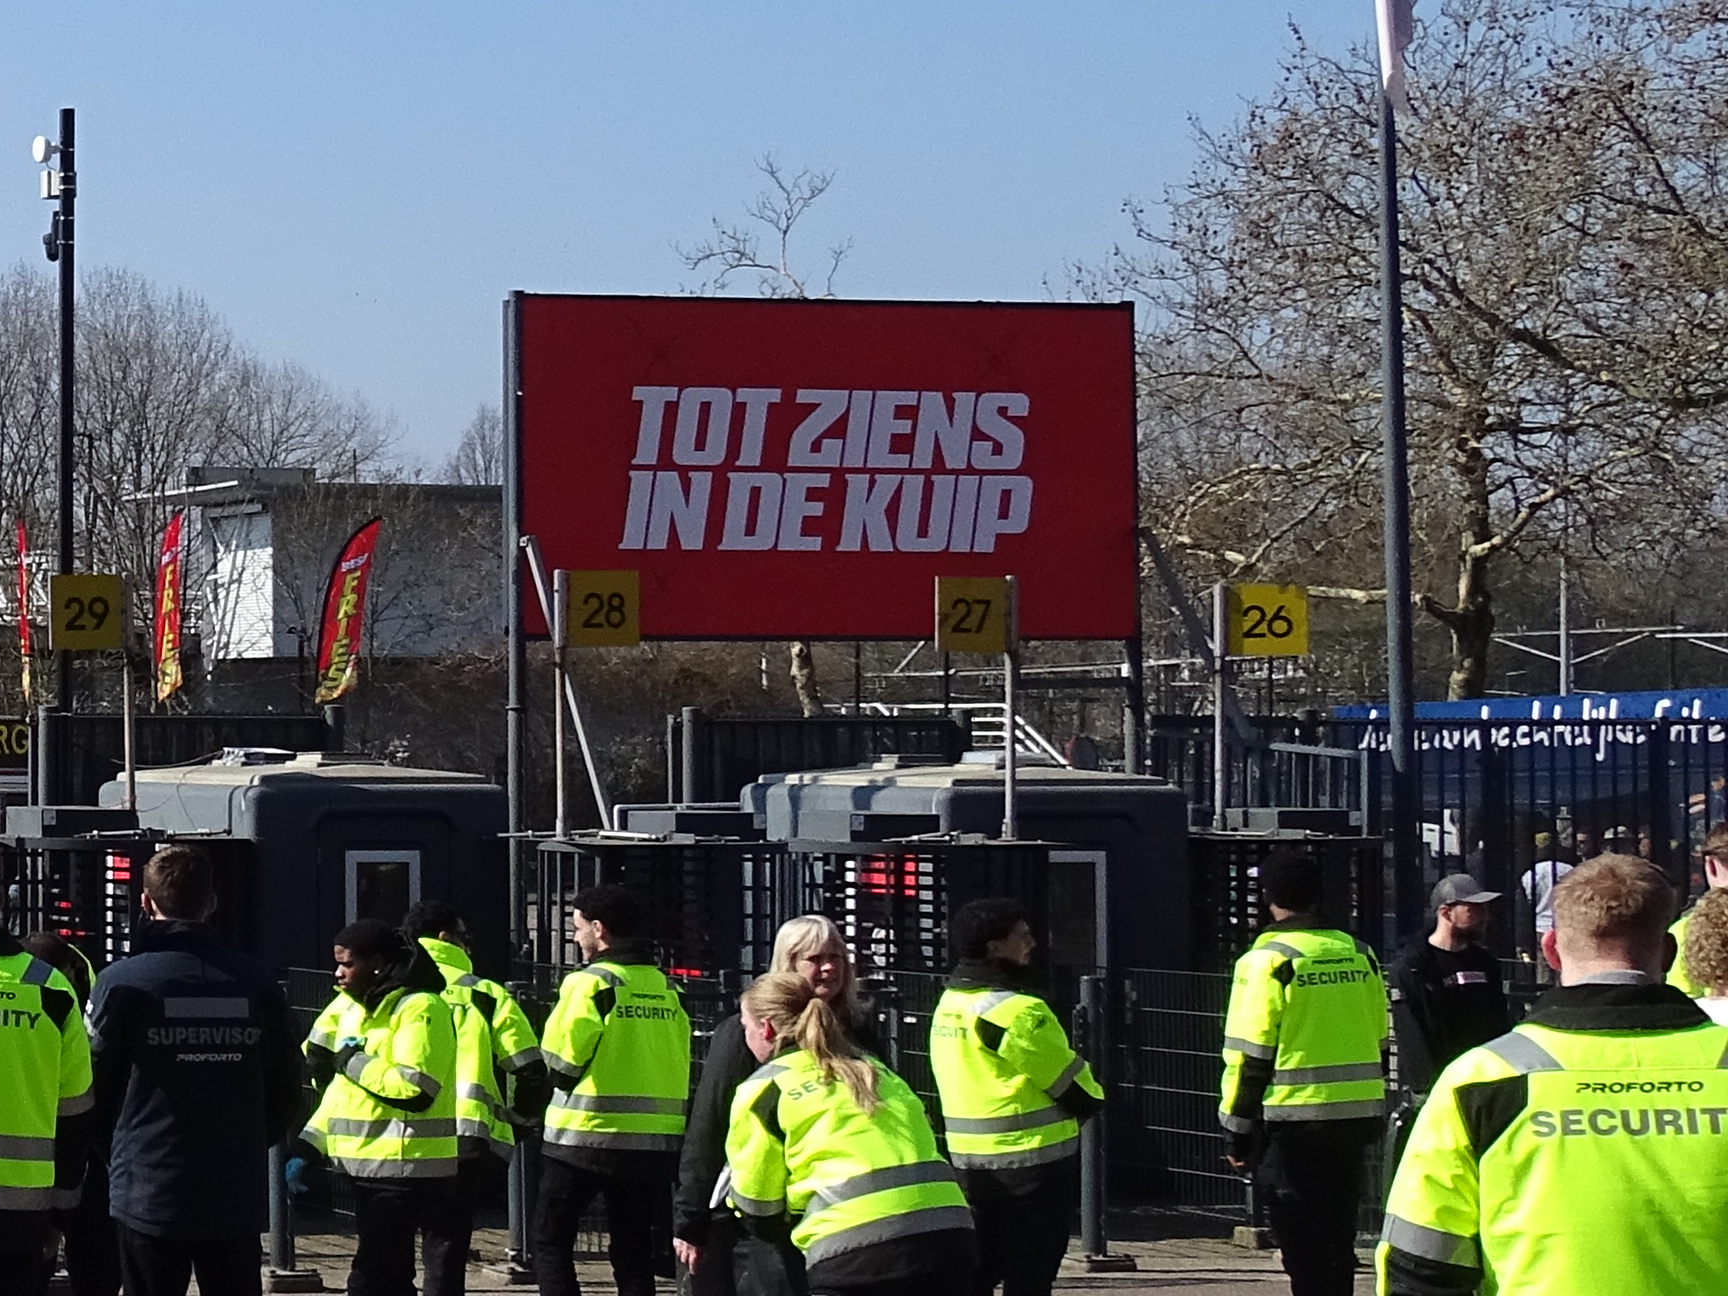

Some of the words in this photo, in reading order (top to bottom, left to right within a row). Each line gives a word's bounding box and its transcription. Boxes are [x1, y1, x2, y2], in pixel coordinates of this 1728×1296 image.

[631, 385, 782, 467] TOT
[787, 389, 1030, 469] ZIENS
[618, 470, 713, 550] IN
[718, 472, 830, 551] DE
[836, 474, 1033, 553] KUIP
[64, 596, 110, 632] 29
[322, 569, 362, 688] FRIES
[582, 592, 626, 630] 28
[951, 598, 993, 635] 27
[1242, 604, 1294, 639] 26
[1297, 970, 1370, 987] SECURITY
[616, 1005, 678, 1021] SECURITY
[175, 1053, 243, 1062] PROFORTO
[1576, 1080, 1705, 1094] PROFORTO
[1529, 1106, 1728, 1138] SECURIT
